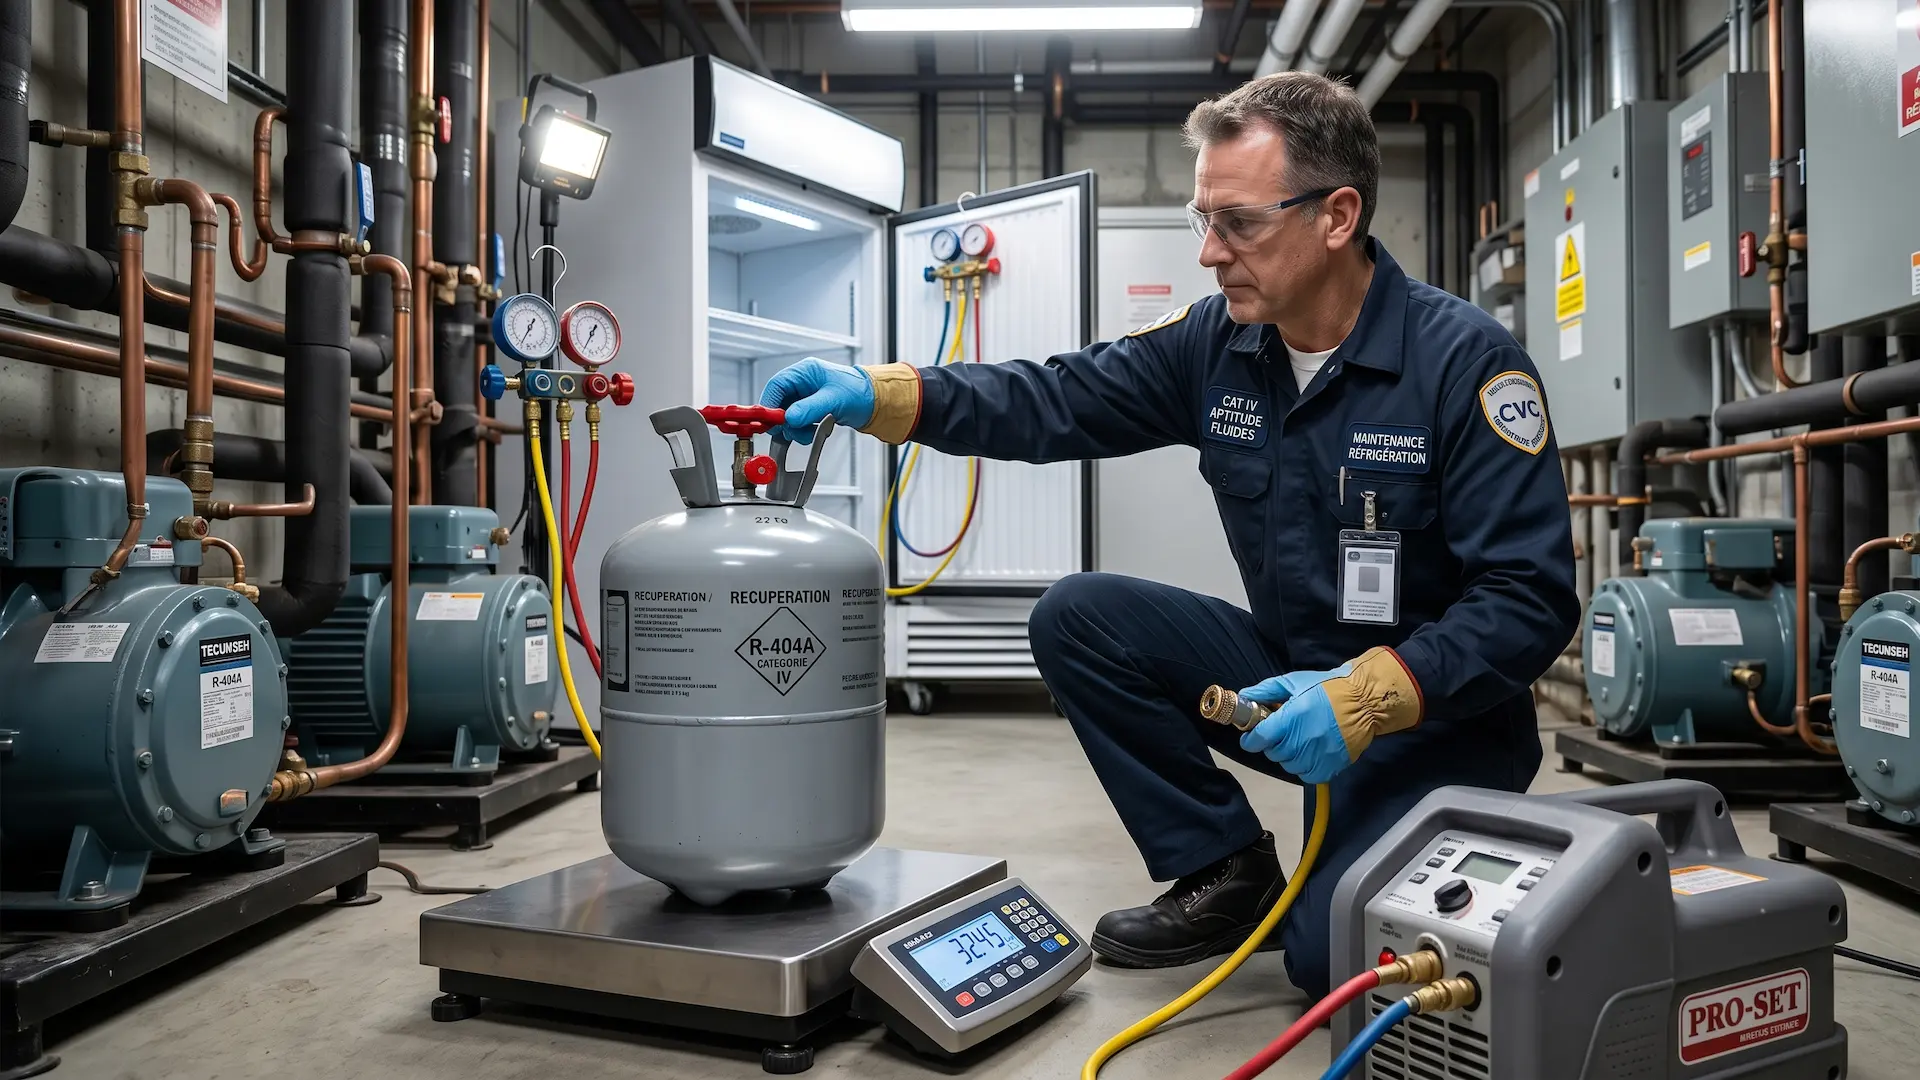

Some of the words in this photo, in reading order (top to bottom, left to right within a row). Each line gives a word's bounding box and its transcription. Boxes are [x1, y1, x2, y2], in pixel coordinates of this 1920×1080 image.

[1222, 395, 1244, 409] CAT
[1246, 399, 1259, 412] IV
[1499, 400, 1540, 422] CVC
[1209, 407, 1263, 428] APTITUDE
[1210, 422, 1256, 441] FLUIDES
[1352, 432, 1425, 449] MAINTENANCE
[1348, 444, 1427, 465] RÉFRIGÉRATION
[754, 516, 770, 524] 22
[634, 591, 706, 602] RECUPERATION
[730, 589, 831, 604] RECUPERATION
[750, 636, 815, 656] R-404A
[757, 657, 808, 668] CATEGORIE
[212, 672, 242, 688] R-404A
[776, 670, 792, 684] IV
[1870, 669, 1898, 684] R-404A
[1688, 981, 1801, 1038] PRO-SET
